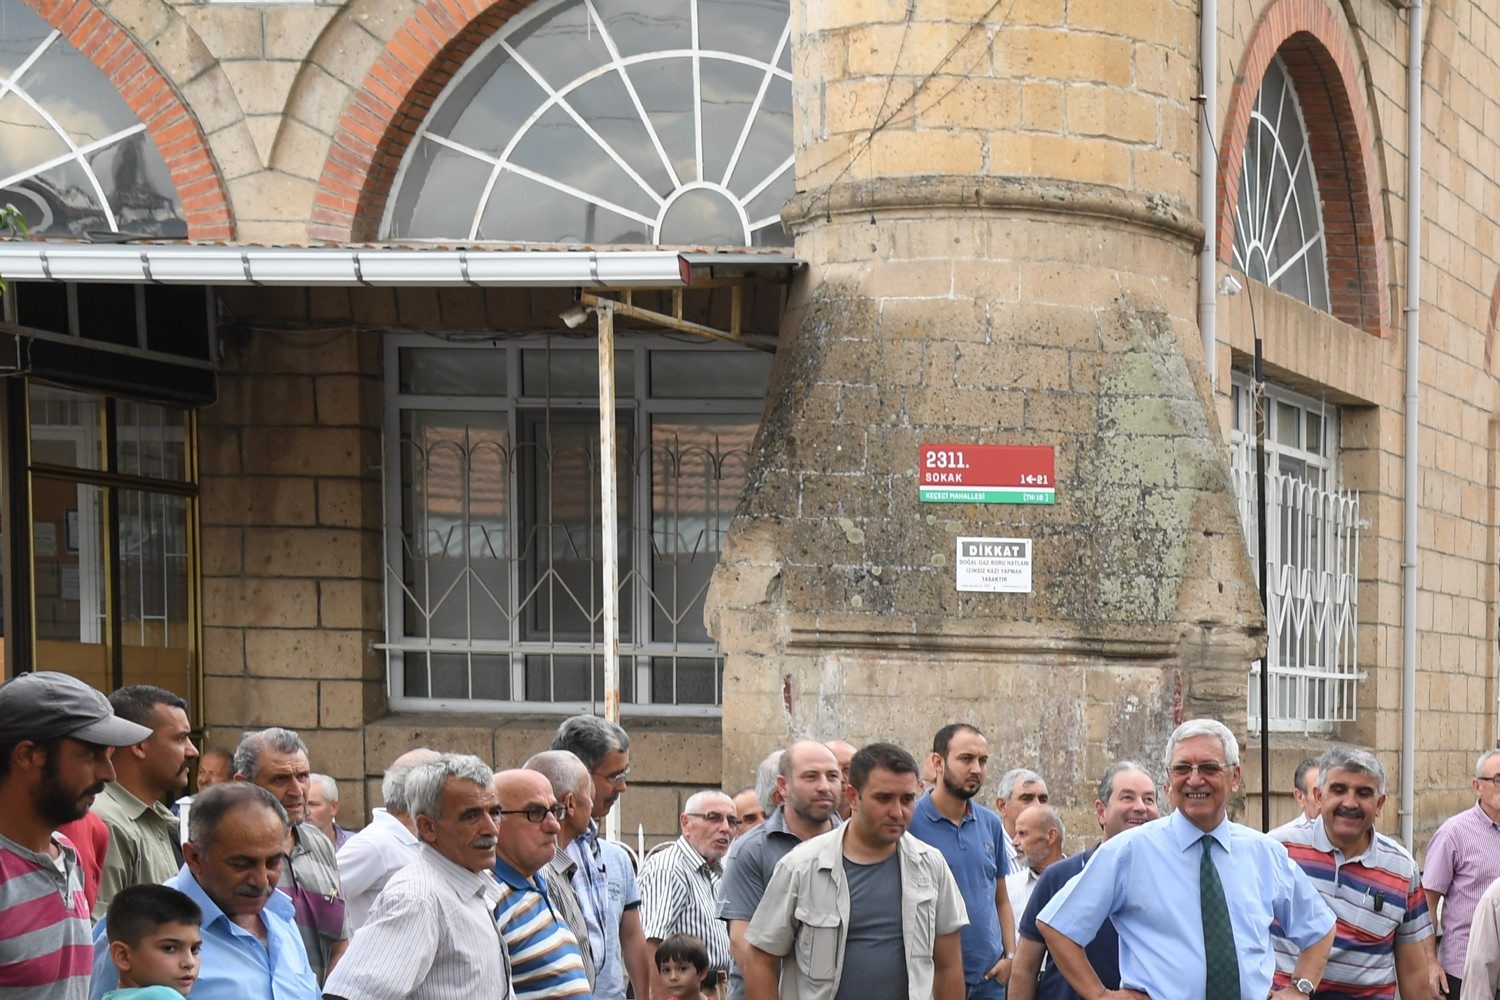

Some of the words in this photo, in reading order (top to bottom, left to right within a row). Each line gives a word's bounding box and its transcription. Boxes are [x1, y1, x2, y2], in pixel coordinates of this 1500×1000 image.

[926, 451, 970, 469] 2311.
[925, 472, 963, 483] SOKAK
[969, 543, 1020, 557] DİKKAT
